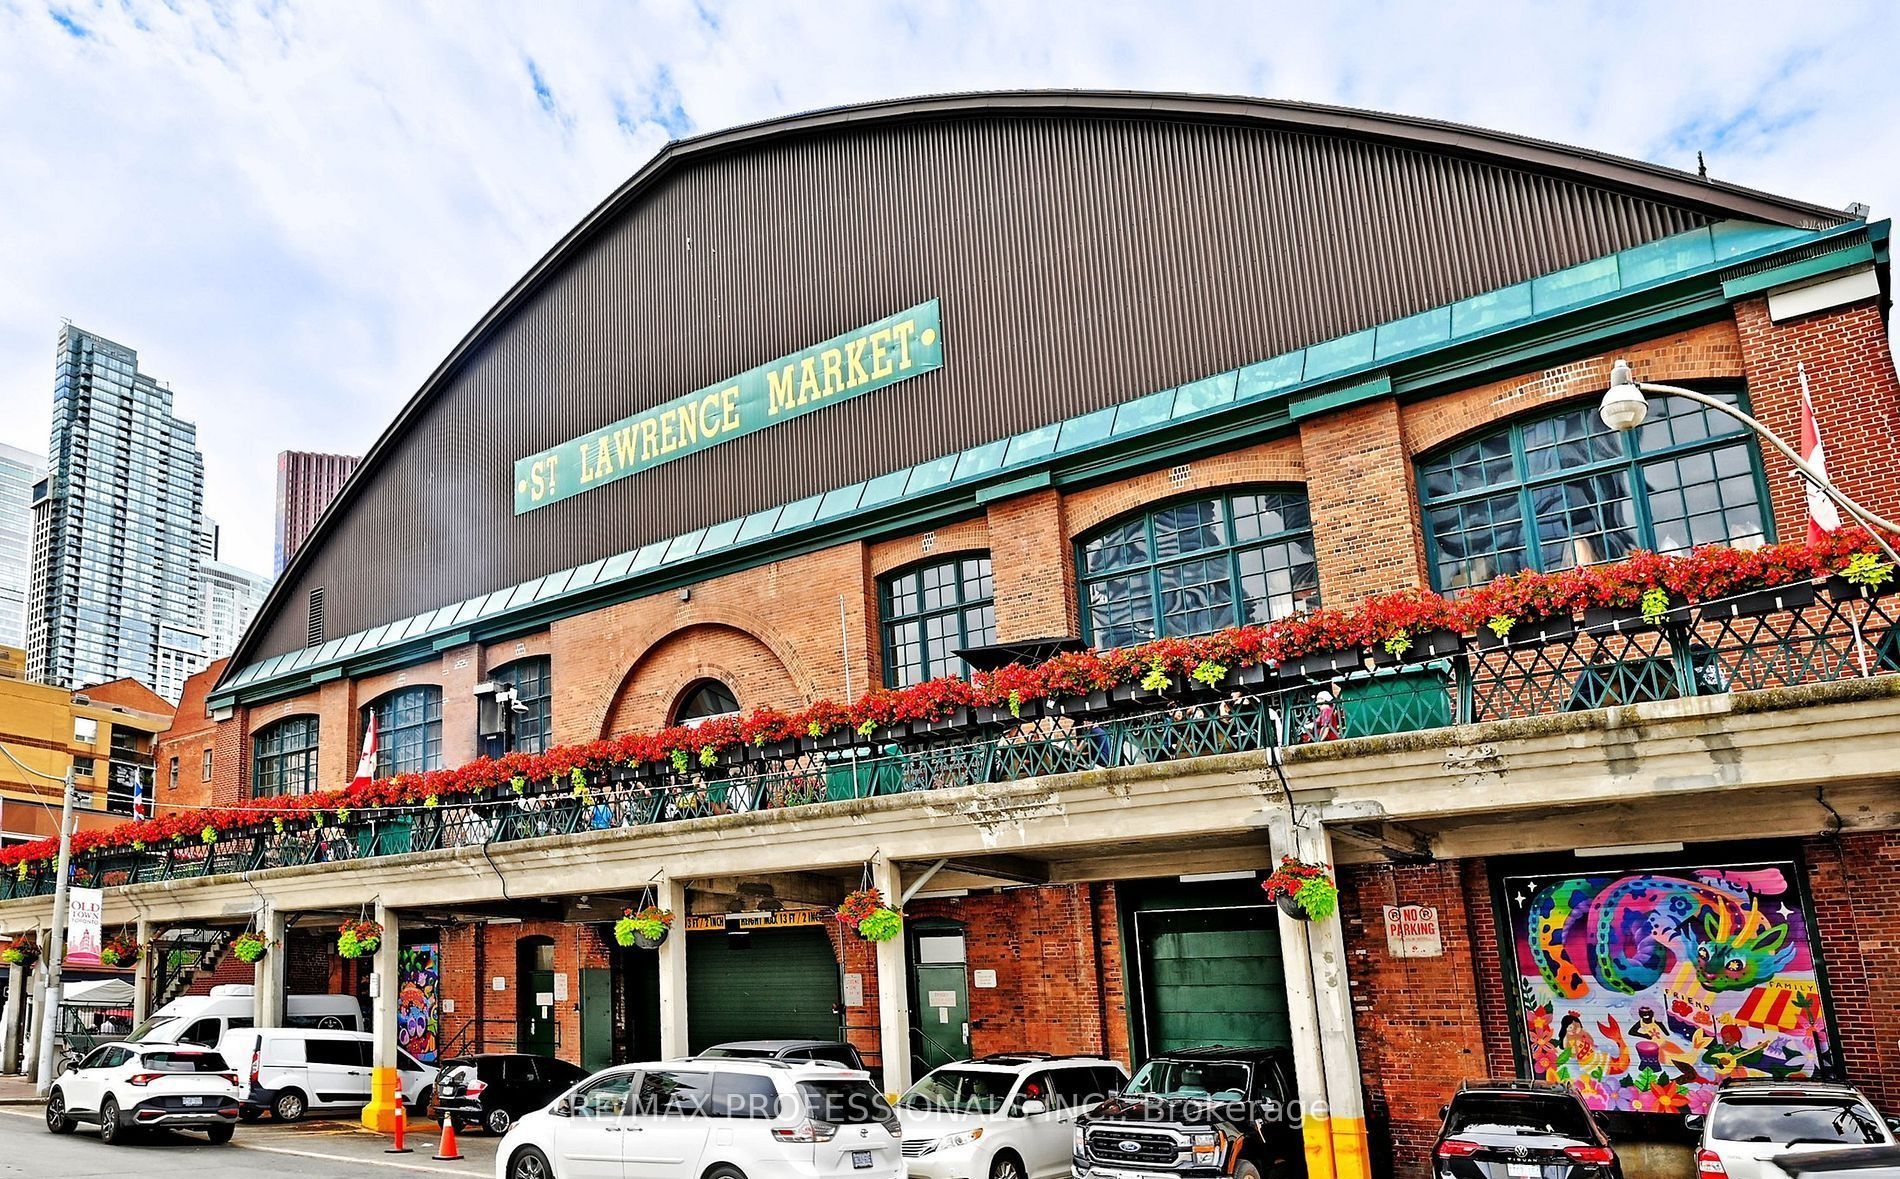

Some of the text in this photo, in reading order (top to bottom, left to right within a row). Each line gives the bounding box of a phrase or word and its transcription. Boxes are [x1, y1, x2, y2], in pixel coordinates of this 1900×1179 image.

[580, 387, 740, 484] LAWRENCE
[767, 319, 914, 415] MARKET
[72, 900, 100, 912] OLD
[72, 911, 99, 919] TOWN
[780, 914, 788, 924] 13
[789, 912, 796, 923] FT
[802, 912, 807, 923] 2
[1404, 908, 1418, 921] NO
[711, 916, 724, 928] INCH
[1390, 922, 1435, 936] PARKING
[1769, 981, 1814, 991] FAMILY
[1664, 988, 1711, 1012] FRIEND
